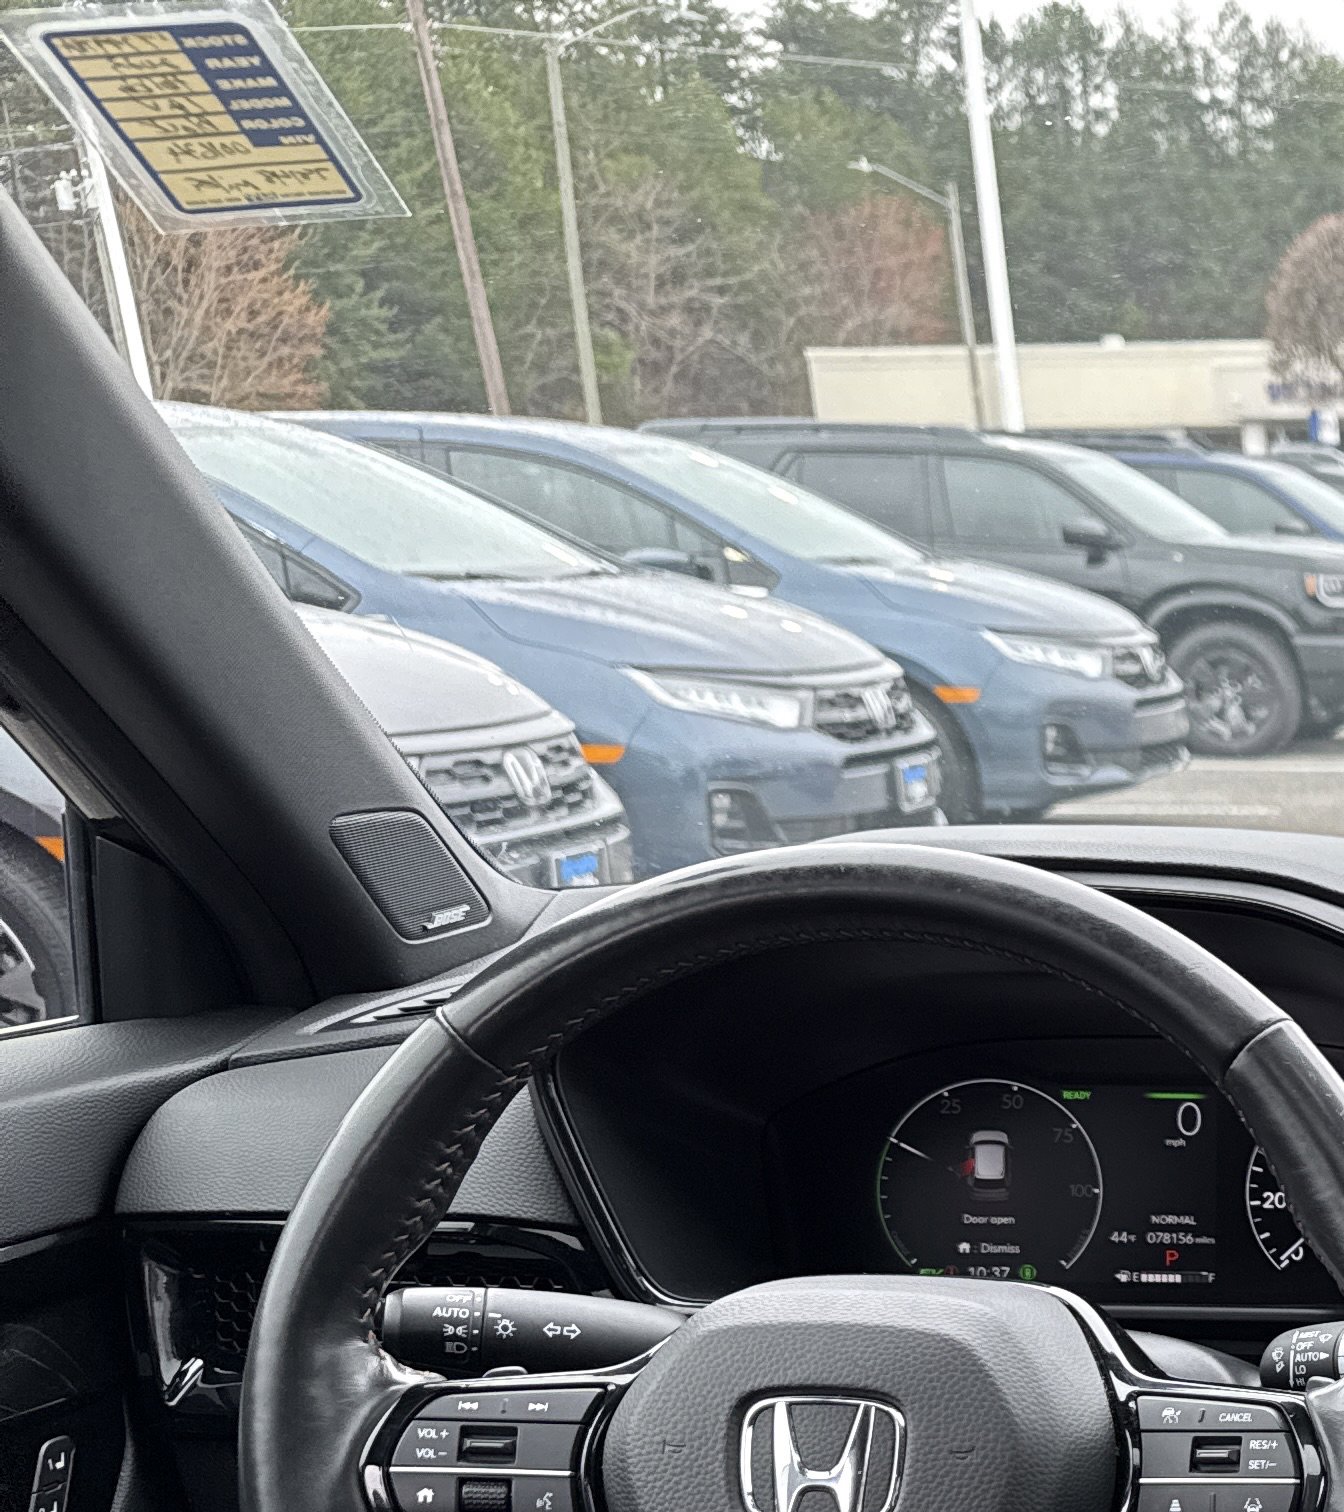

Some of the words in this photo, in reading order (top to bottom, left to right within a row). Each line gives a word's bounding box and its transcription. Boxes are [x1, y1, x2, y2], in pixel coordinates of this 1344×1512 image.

[940, 1100, 962, 1115] 25
[1002, 1095, 1024, 1110] 50
[1177, 1101, 1202, 1136] 0
[1053, 1128, 1074, 1143] 75
[1164, 1138, 1187, 1148] mph
[1069, 1184, 1094, 1198] 100
[962, 1213, 988, 1225] Door
[990, 1215, 1016, 1226] open
[1151, 1215, 1197, 1225] NORMAL
[1146, 1232, 1194, 1244] 078156
[980, 1243, 1021, 1254] Dismiss
[1166, 1250, 1180, 1265] P
[1132, 1273, 1140, 1282] E
[432, 1307, 470, 1319] AUTO
[1296, 1341, 1315, 1351] OFF
[1294, 1352, 1319, 1362] AUTO
[1294, 1365, 1307, 1375] LO
[1218, 1412, 1253, 1423] CANCEL
